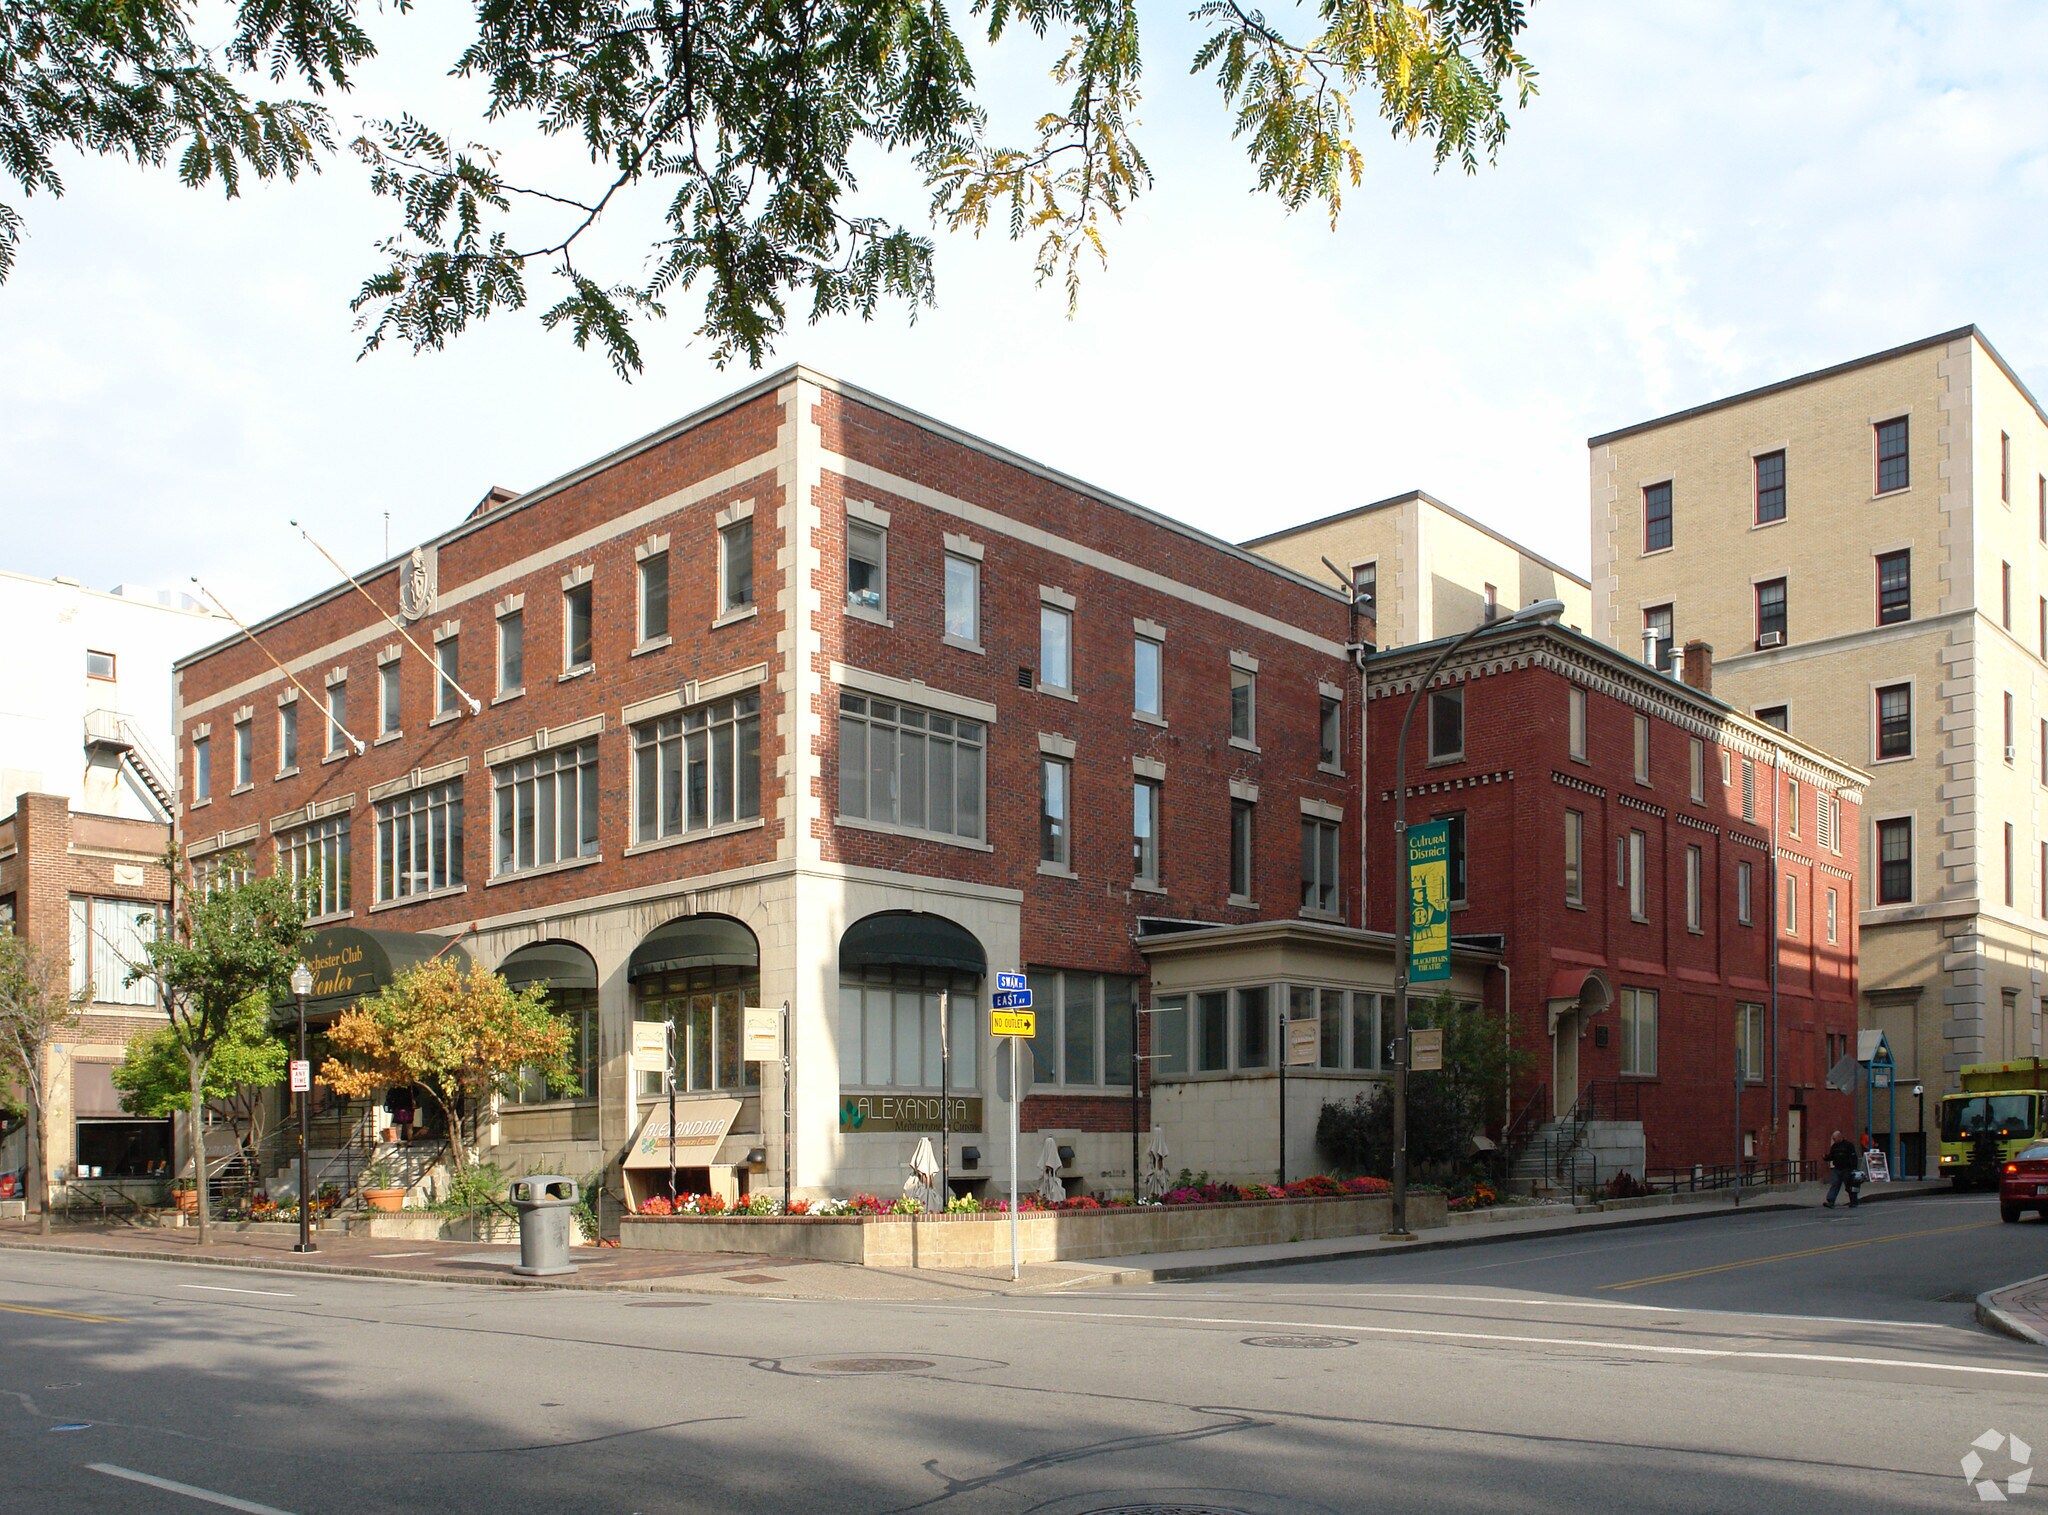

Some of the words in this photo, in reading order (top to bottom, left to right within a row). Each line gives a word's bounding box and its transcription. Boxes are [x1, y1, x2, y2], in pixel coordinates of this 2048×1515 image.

[1410, 831, 1446, 848] Cultural
[1410, 846, 1446, 860] District
[341, 945, 363, 965] Club
[1001, 976, 1018, 988] SWAN
[997, 994, 1017, 1006] EAST
[995, 1018, 1002, 1028] NO
[1004, 1018, 1023, 1028] OUTLET
[858, 1097, 967, 1120] ALEXANDRIA
[895, 1119, 952, 1132] Mediterranen
